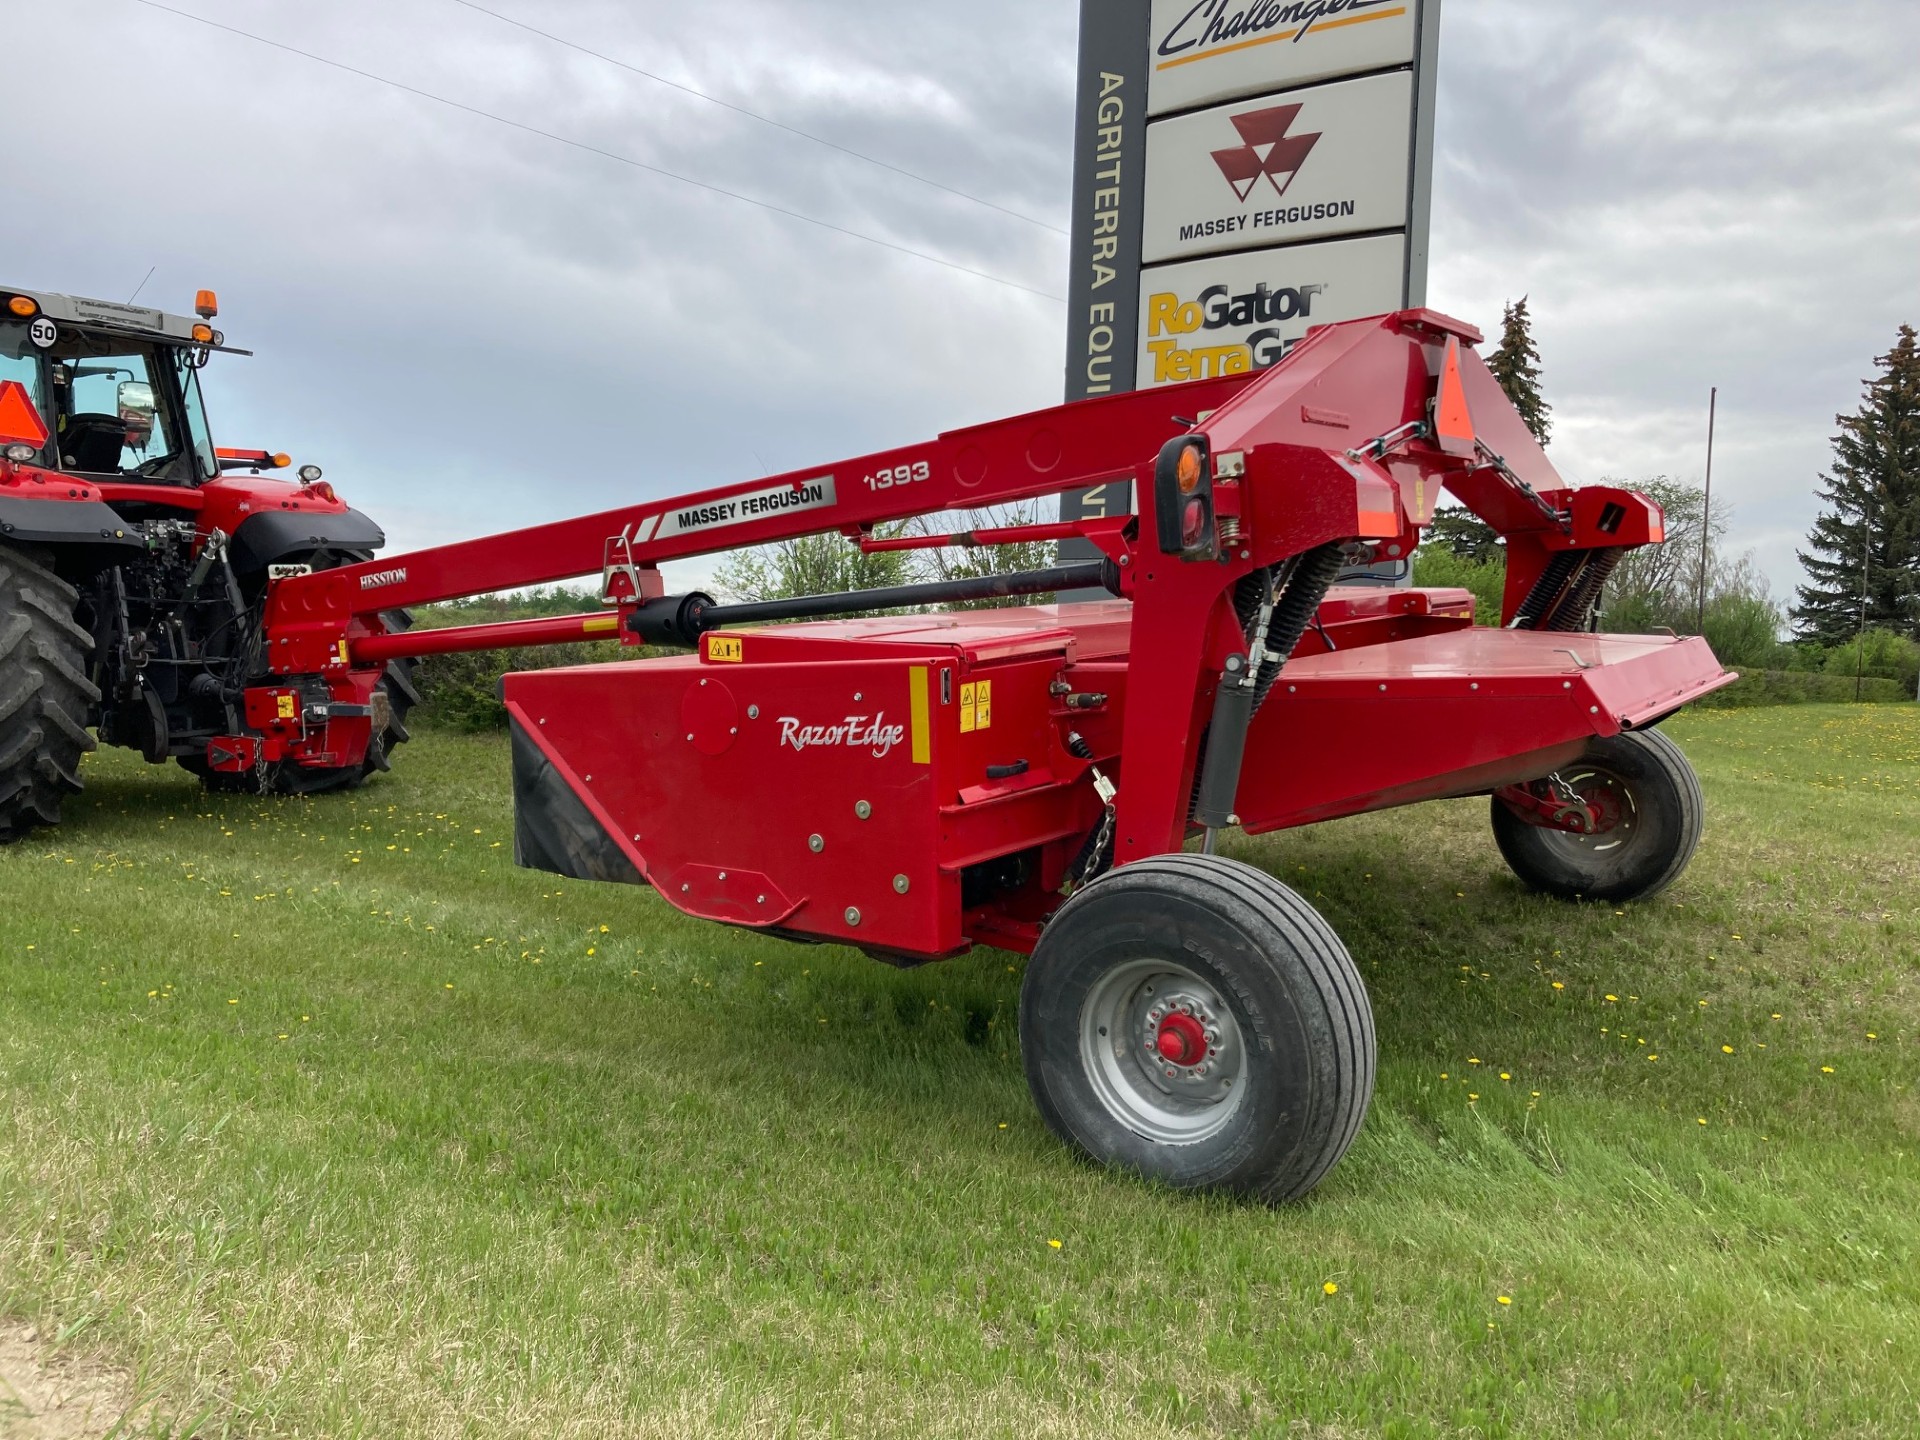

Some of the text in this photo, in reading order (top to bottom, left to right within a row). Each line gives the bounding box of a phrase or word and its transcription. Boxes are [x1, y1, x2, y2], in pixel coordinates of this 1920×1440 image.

[1091, 71, 1124, 290] AGRITERRA
[1179, 199, 1355, 242] MASSEY FERGUSON
[1148, 282, 1322, 337] RoGator
[32, 324, 55, 341] 50
[863, 461, 930, 491] 1393
[678, 484, 824, 529] MASSEY FERGUSON
[359, 567, 407, 591] HESSTON
[776, 711, 904, 759] RazorEdge
[1183, 937, 1273, 1052] CARLISLE
